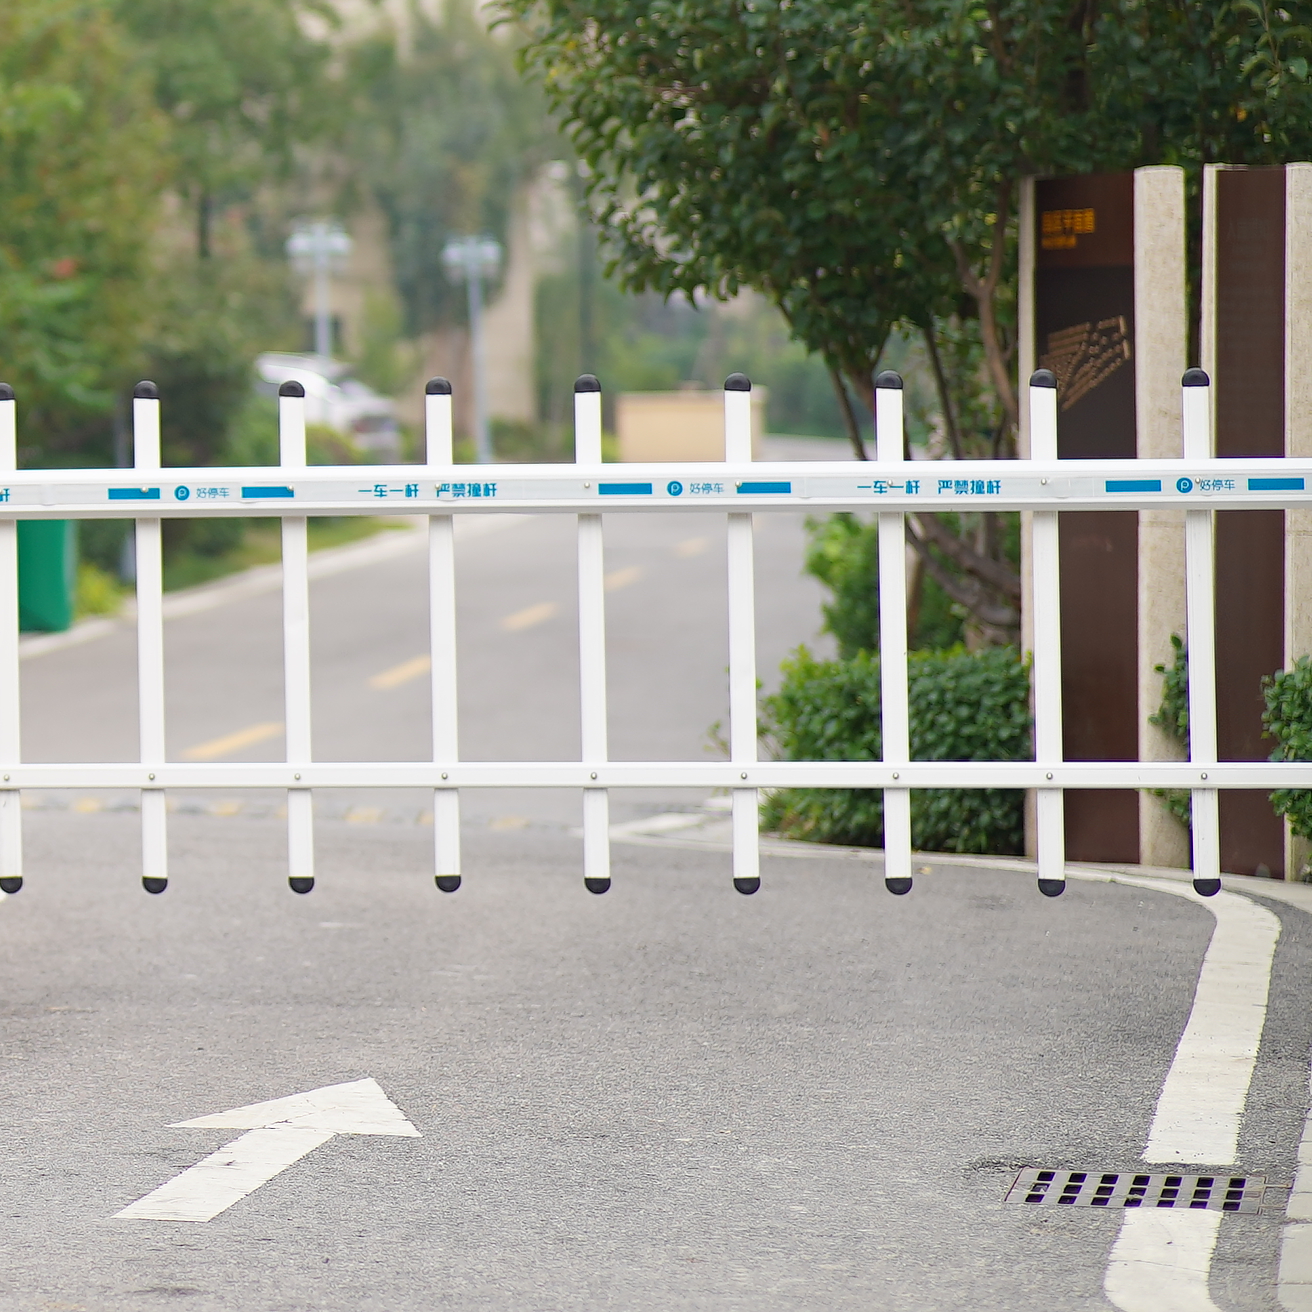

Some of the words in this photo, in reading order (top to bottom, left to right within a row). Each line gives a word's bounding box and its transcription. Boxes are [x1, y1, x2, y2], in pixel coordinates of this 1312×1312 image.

[358, 483, 419, 498] 一车一杆
[435, 482, 497, 498] 严禁撞杆
[689, 482, 724, 495] 好停车
[857, 479, 920, 495] 一车一杆
[937, 479, 1001, 495] 严禁撞杆
[1199, 479, 1236, 491] 好停车
[196, 487, 230, 499] 好停车
